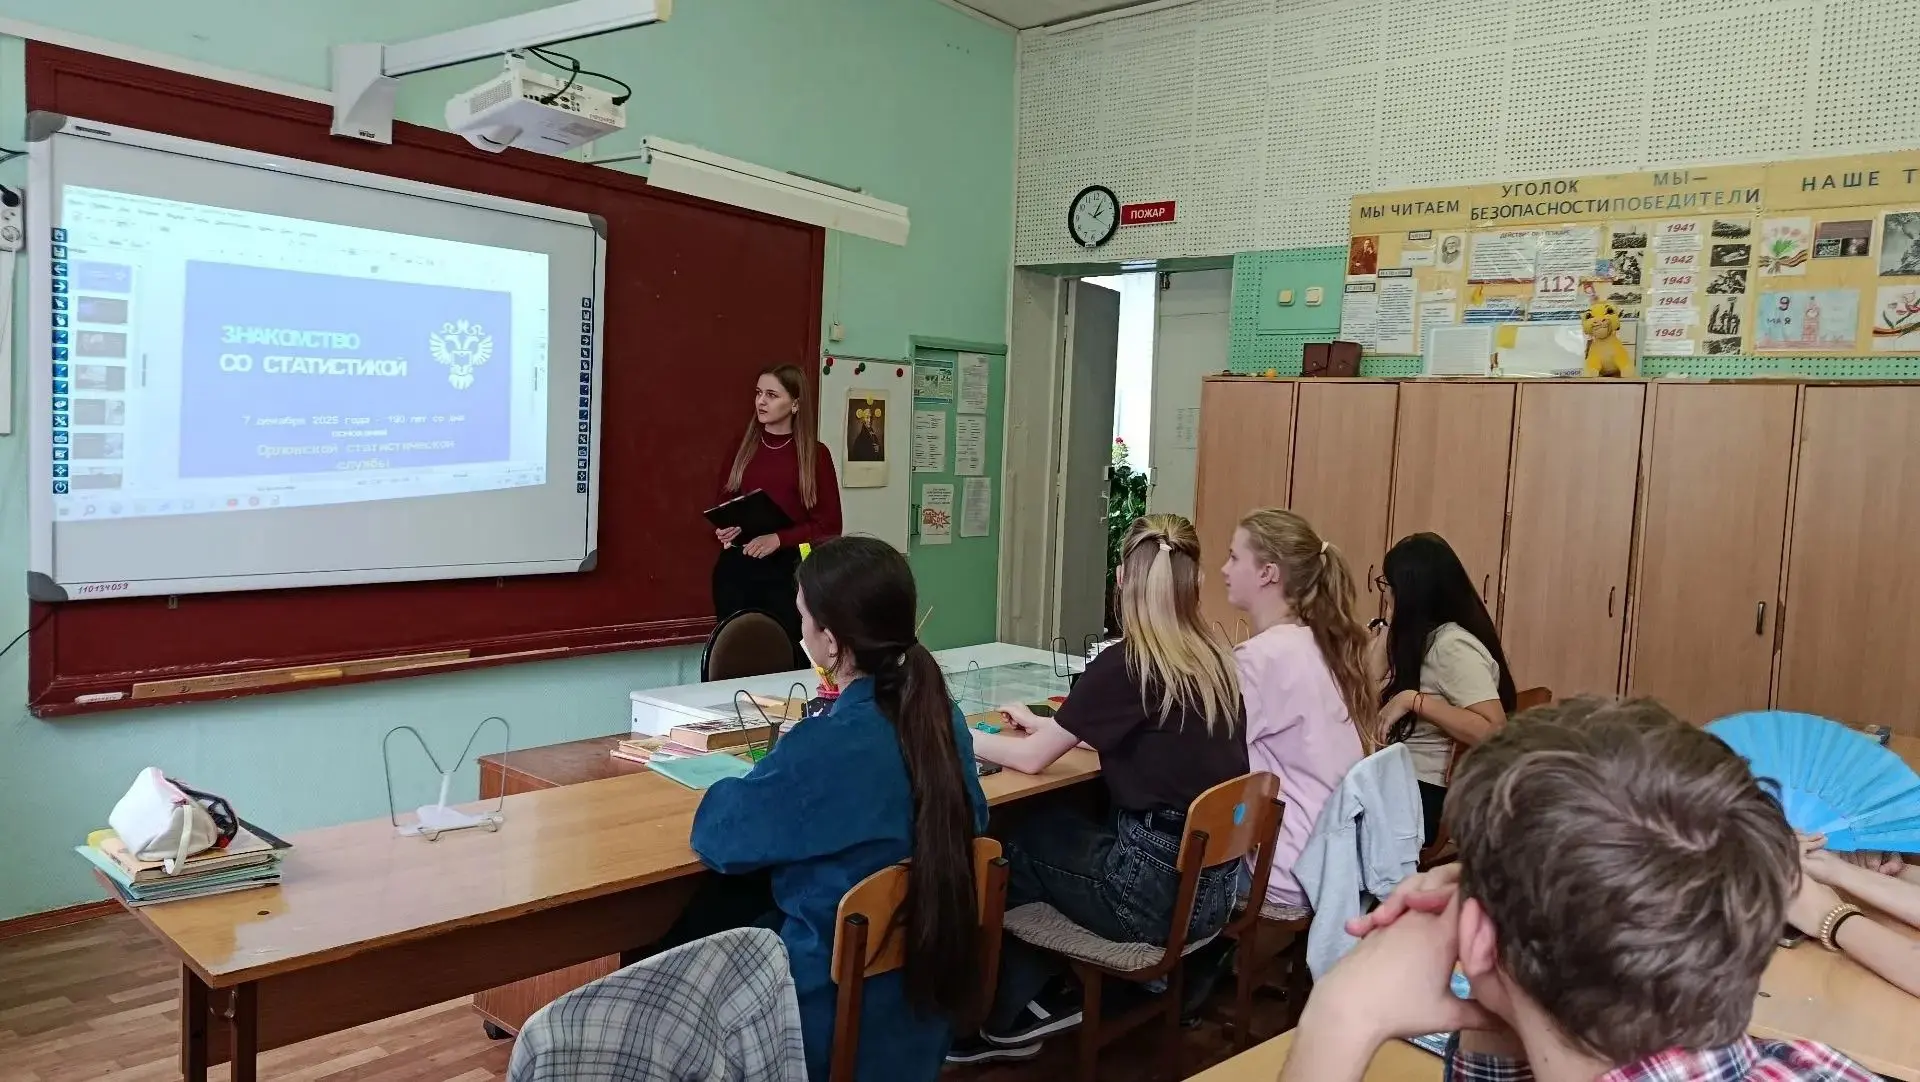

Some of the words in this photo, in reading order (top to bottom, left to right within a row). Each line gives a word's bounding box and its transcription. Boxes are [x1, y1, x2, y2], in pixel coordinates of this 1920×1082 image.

[1502, 180, 1580, 198] УГОЛОК
[1802, 171, 1880, 192] НАШЕ
[1613, 188, 1760, 212] ПОБЕДИТЕЛИ
[1130, 208, 1166, 219] ПОЖАР
[1360, 206, 1385, 218] МЫ
[1392, 200, 1459, 216] ЧИТАЕМ
[1471, 199, 1609, 220] БЕЗОПАСНОСТИ
[1667, 223, 1696, 232] 1941
[1665, 255, 1694, 264] 1942
[1540, 276, 1575, 292] 112
[1663, 276, 1692, 285] 1943
[1660, 297, 1688, 305] 1944
[1779, 296, 1790, 311] 9
[222, 325, 360, 350] ЗНАКОМСТВО
[1655, 328, 1683, 337] 1945
[220, 354, 252, 372] СО
[263, 355, 408, 377] СТАТИСТИКОЙ
[312, 416, 338, 425] 2025
